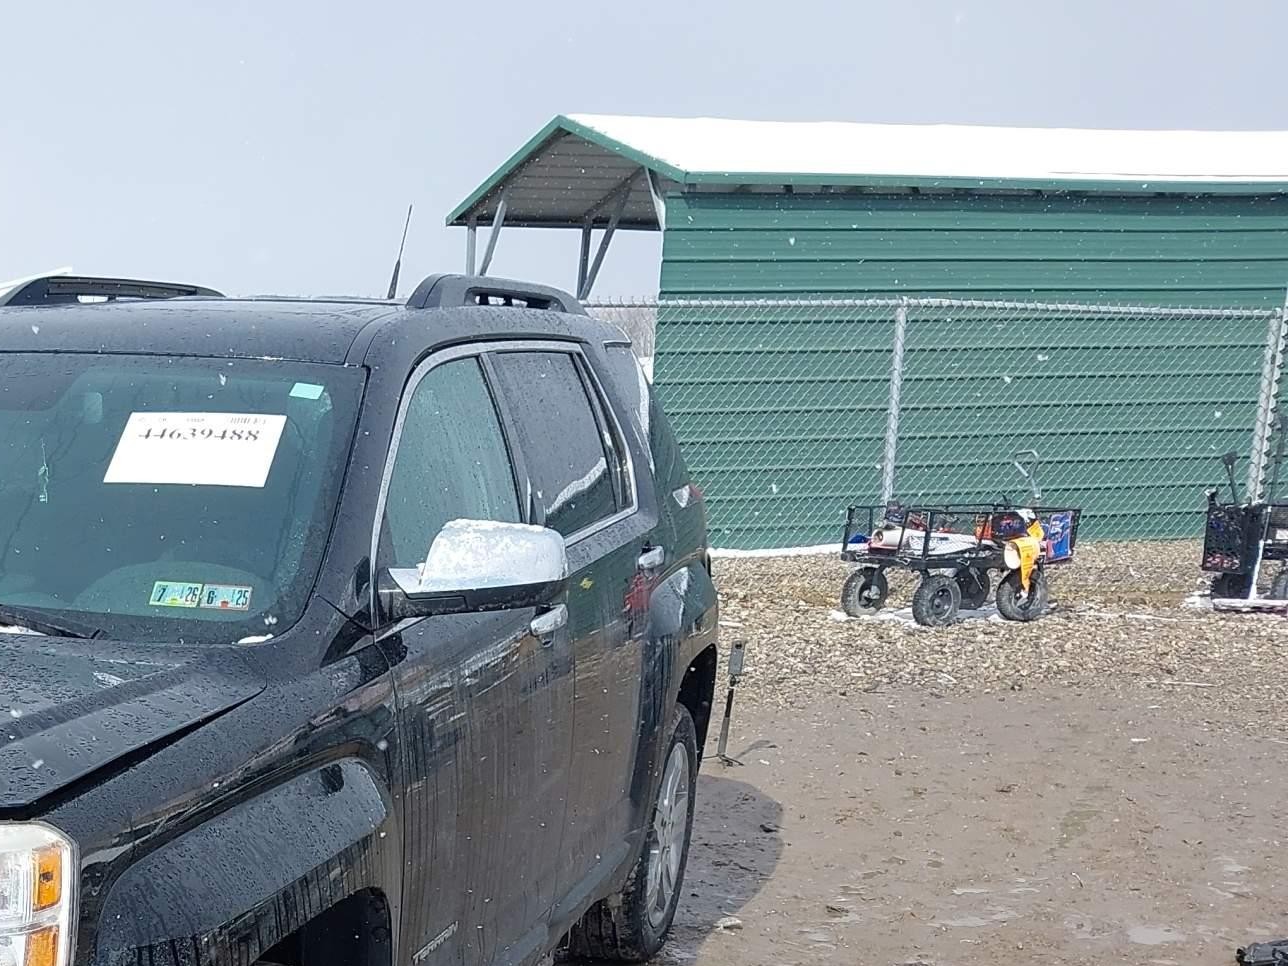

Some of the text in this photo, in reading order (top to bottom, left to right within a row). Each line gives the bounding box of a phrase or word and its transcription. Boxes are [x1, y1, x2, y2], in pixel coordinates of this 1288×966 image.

[138, 427, 261, 442] 44639488
[157, 588, 167, 602] 7
[236, 590, 249, 606] 25
